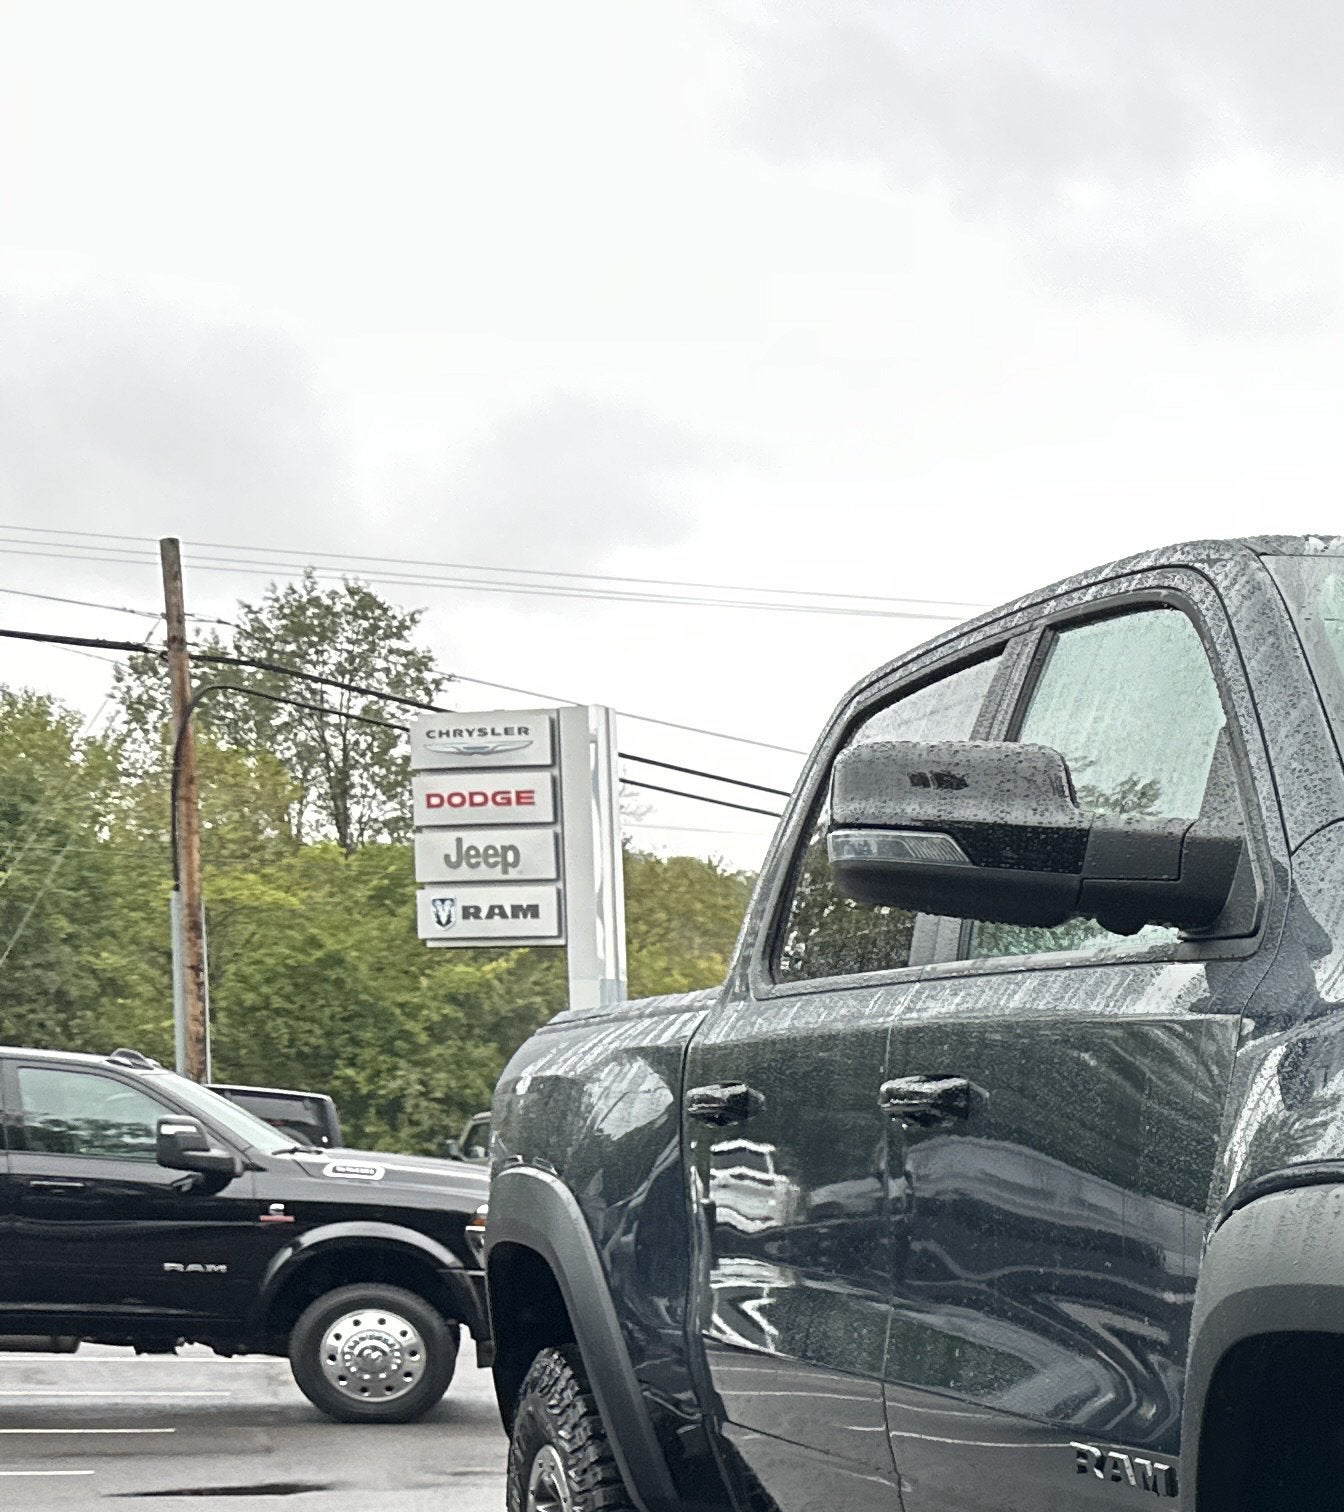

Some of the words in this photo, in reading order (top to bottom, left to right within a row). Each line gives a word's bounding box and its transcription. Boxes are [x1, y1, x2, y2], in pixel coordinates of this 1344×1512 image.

[425, 726, 530, 740] CHRYSLER
[425, 789, 536, 809] DODGE
[443, 837, 521, 875] Jeep
[461, 904, 541, 921] RAM
[163, 1262, 228, 1274] RAM
[1070, 1441, 1179, 1498] RAM
